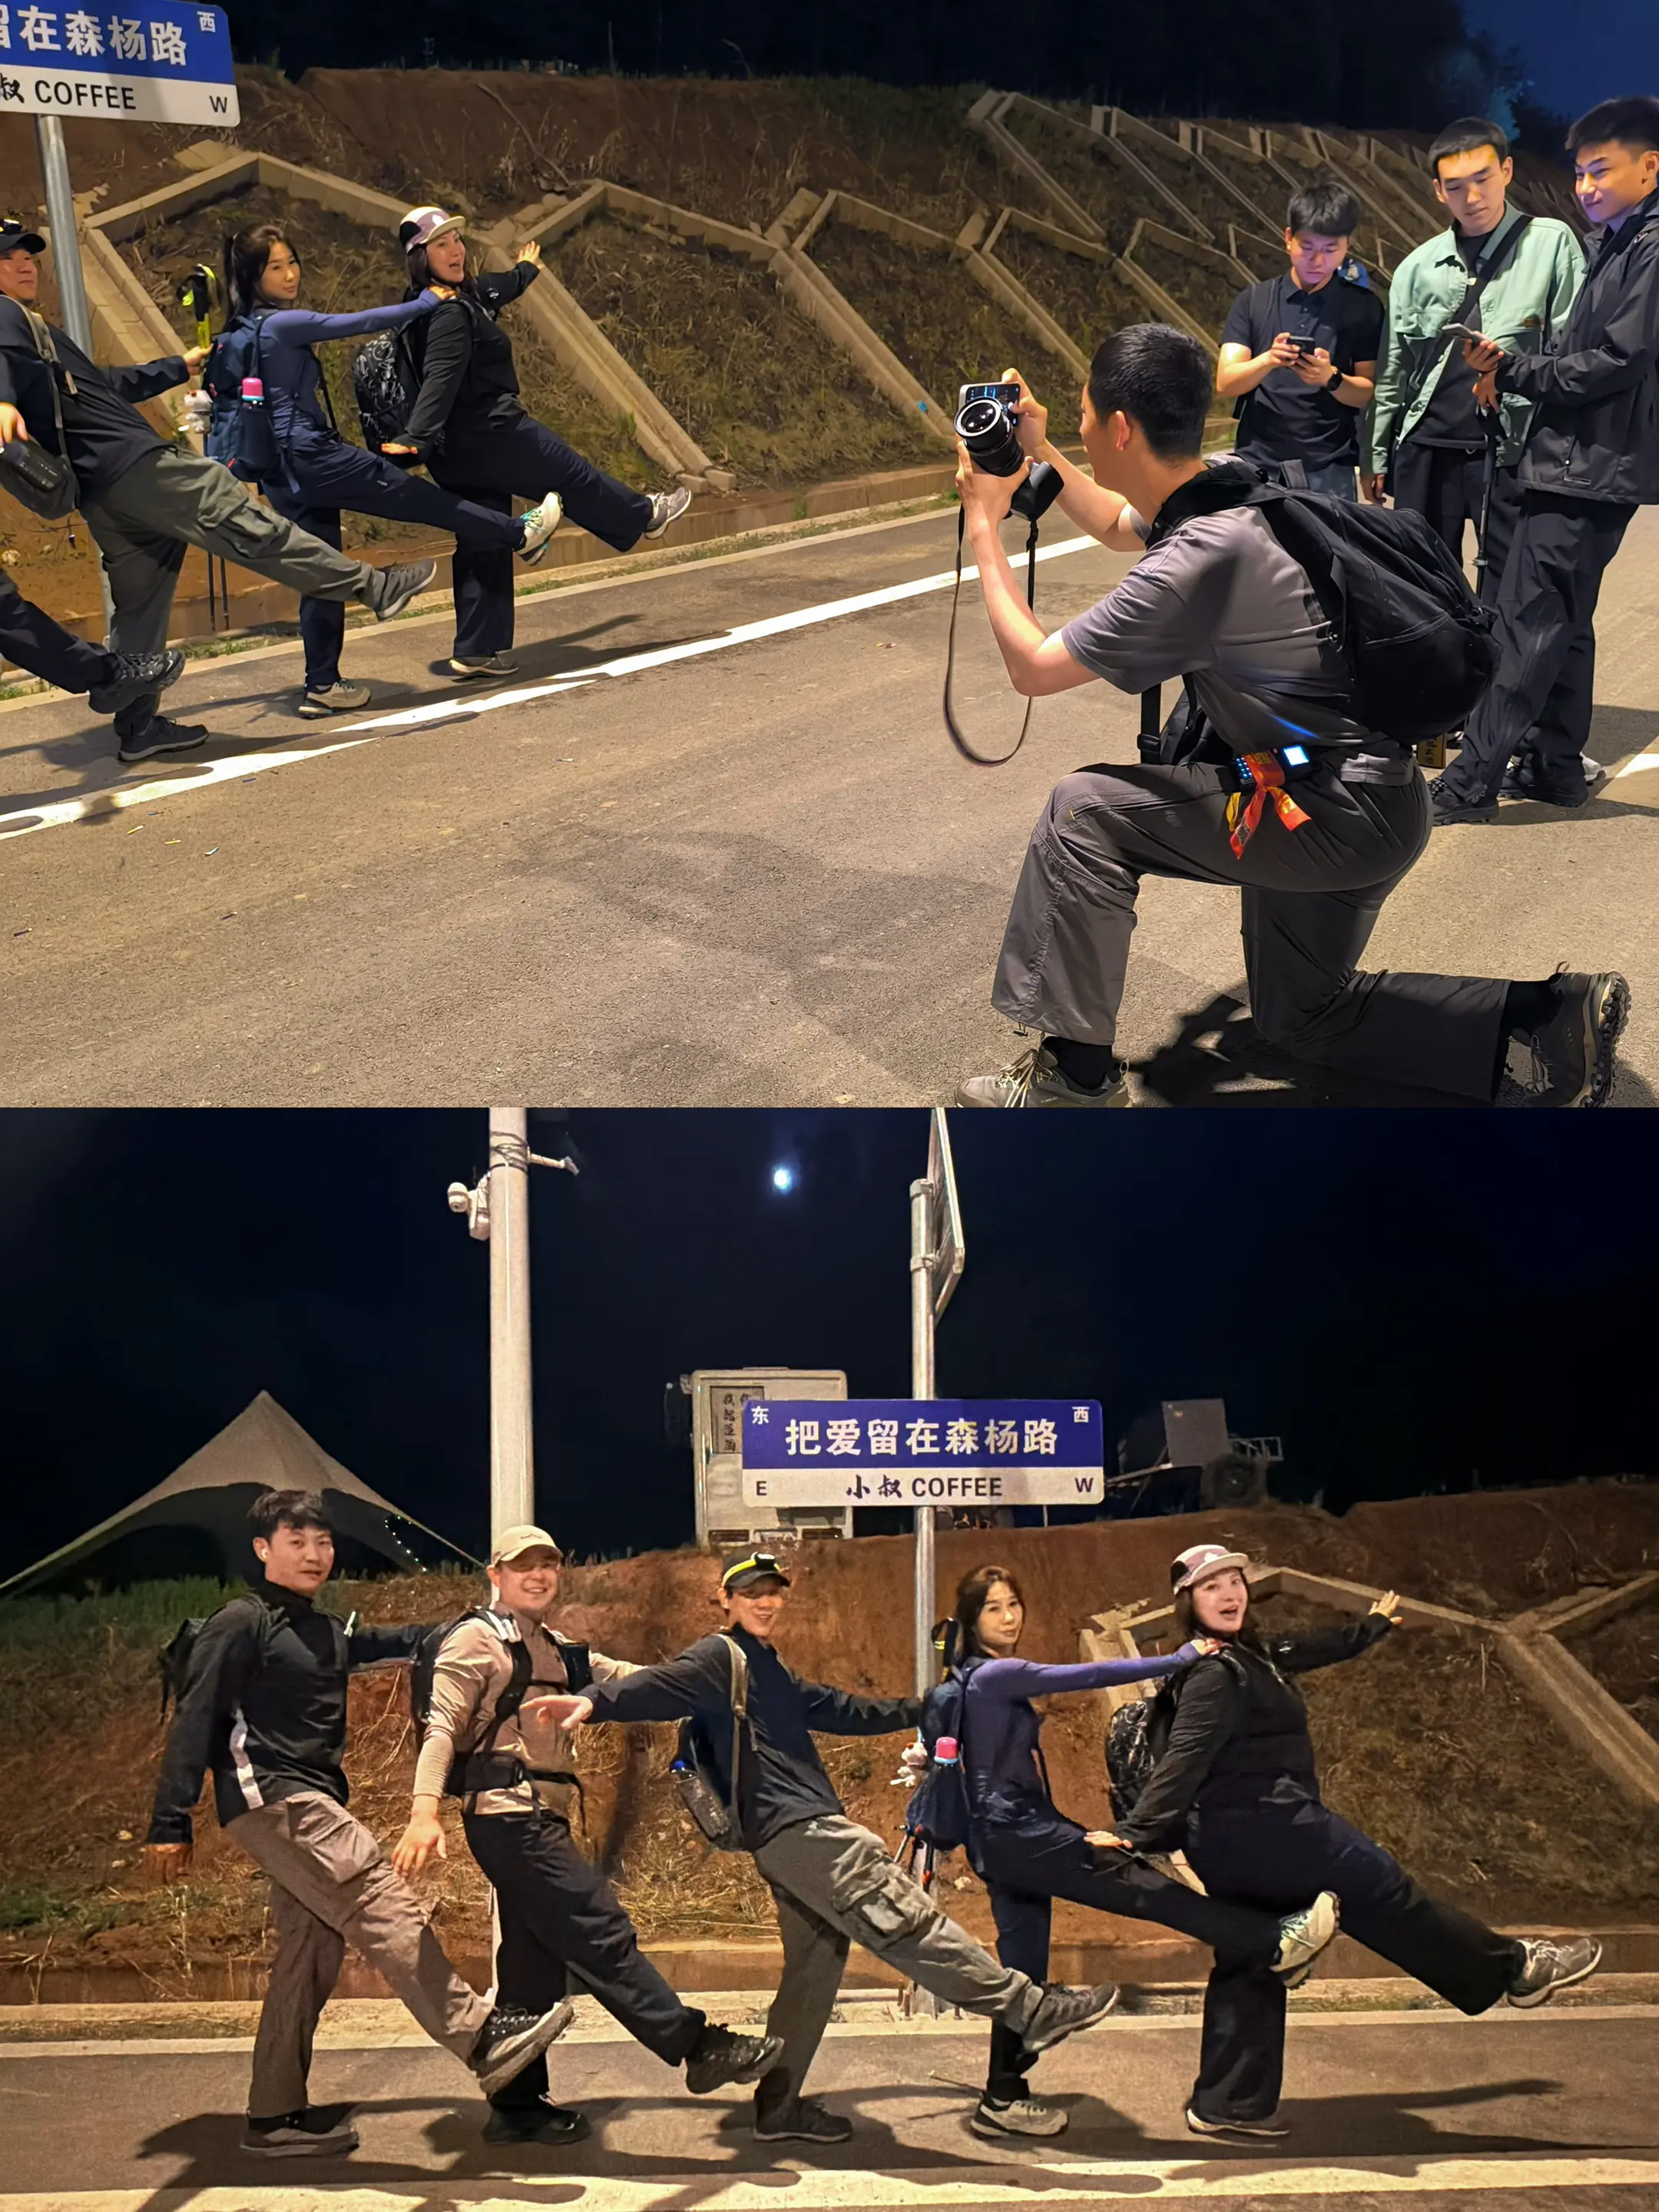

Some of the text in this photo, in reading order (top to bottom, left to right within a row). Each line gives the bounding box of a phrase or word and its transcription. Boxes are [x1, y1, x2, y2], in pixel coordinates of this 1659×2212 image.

[197, 11, 216, 33] 西
[0, 4, 187, 66] 在森杨路
[35, 79, 137, 111] COFFEE
[210, 95, 228, 114] W
[750, 1406, 770, 1425] 东
[1071, 1406, 1090, 1423] 西
[785, 1418, 1058, 1456] 把爱留在森杨路
[756, 1480, 767, 1496] E
[846, 1474, 1003, 1499] 小叔 COFFEE
[1074, 1477, 1094, 1493] W
